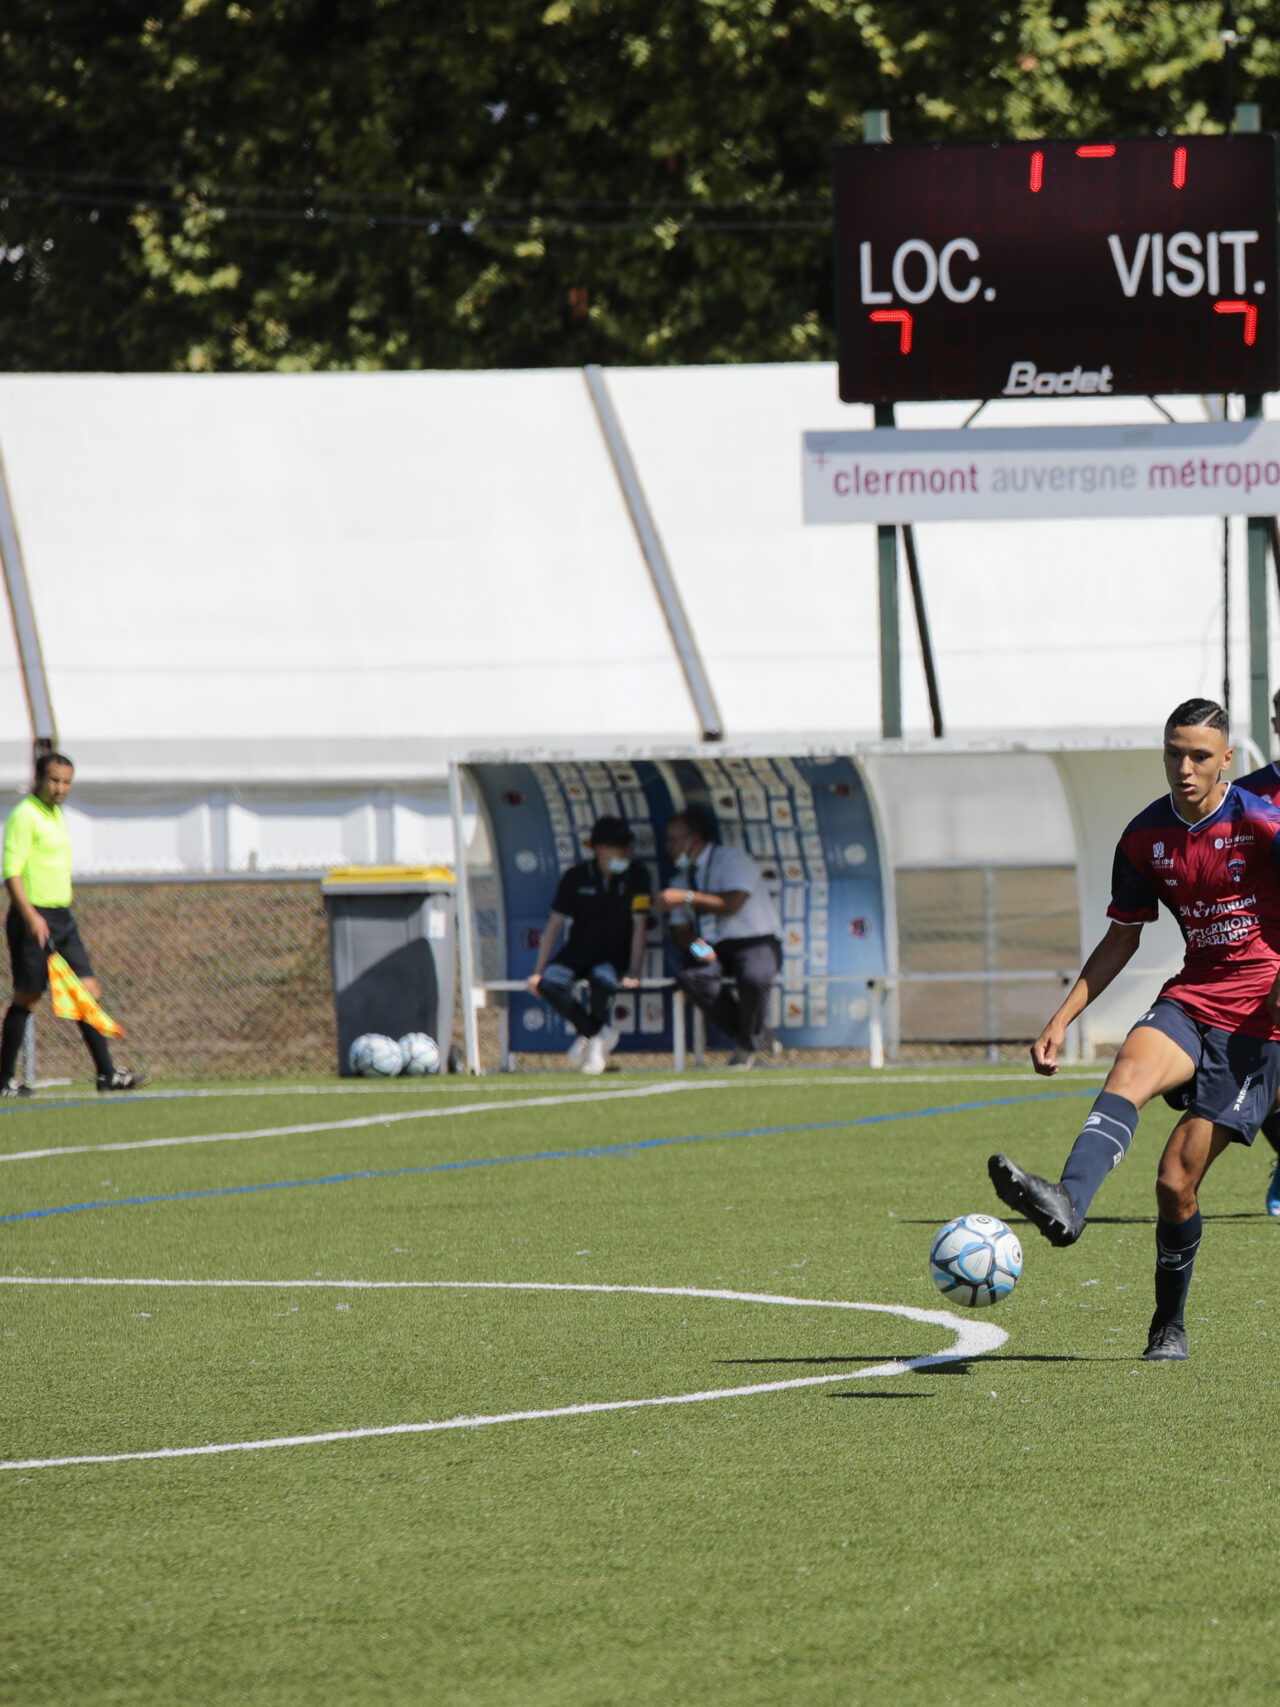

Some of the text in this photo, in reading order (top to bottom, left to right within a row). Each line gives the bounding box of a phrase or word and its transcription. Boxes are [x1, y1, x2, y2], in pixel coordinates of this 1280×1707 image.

[859, 237, 996, 304] LOC.
[1107, 231, 1266, 298] VISIT.
[1002, 361, 1113, 396] Bodet
[834, 463, 979, 496] clermont
[991, 463, 1137, 493] auvergne
